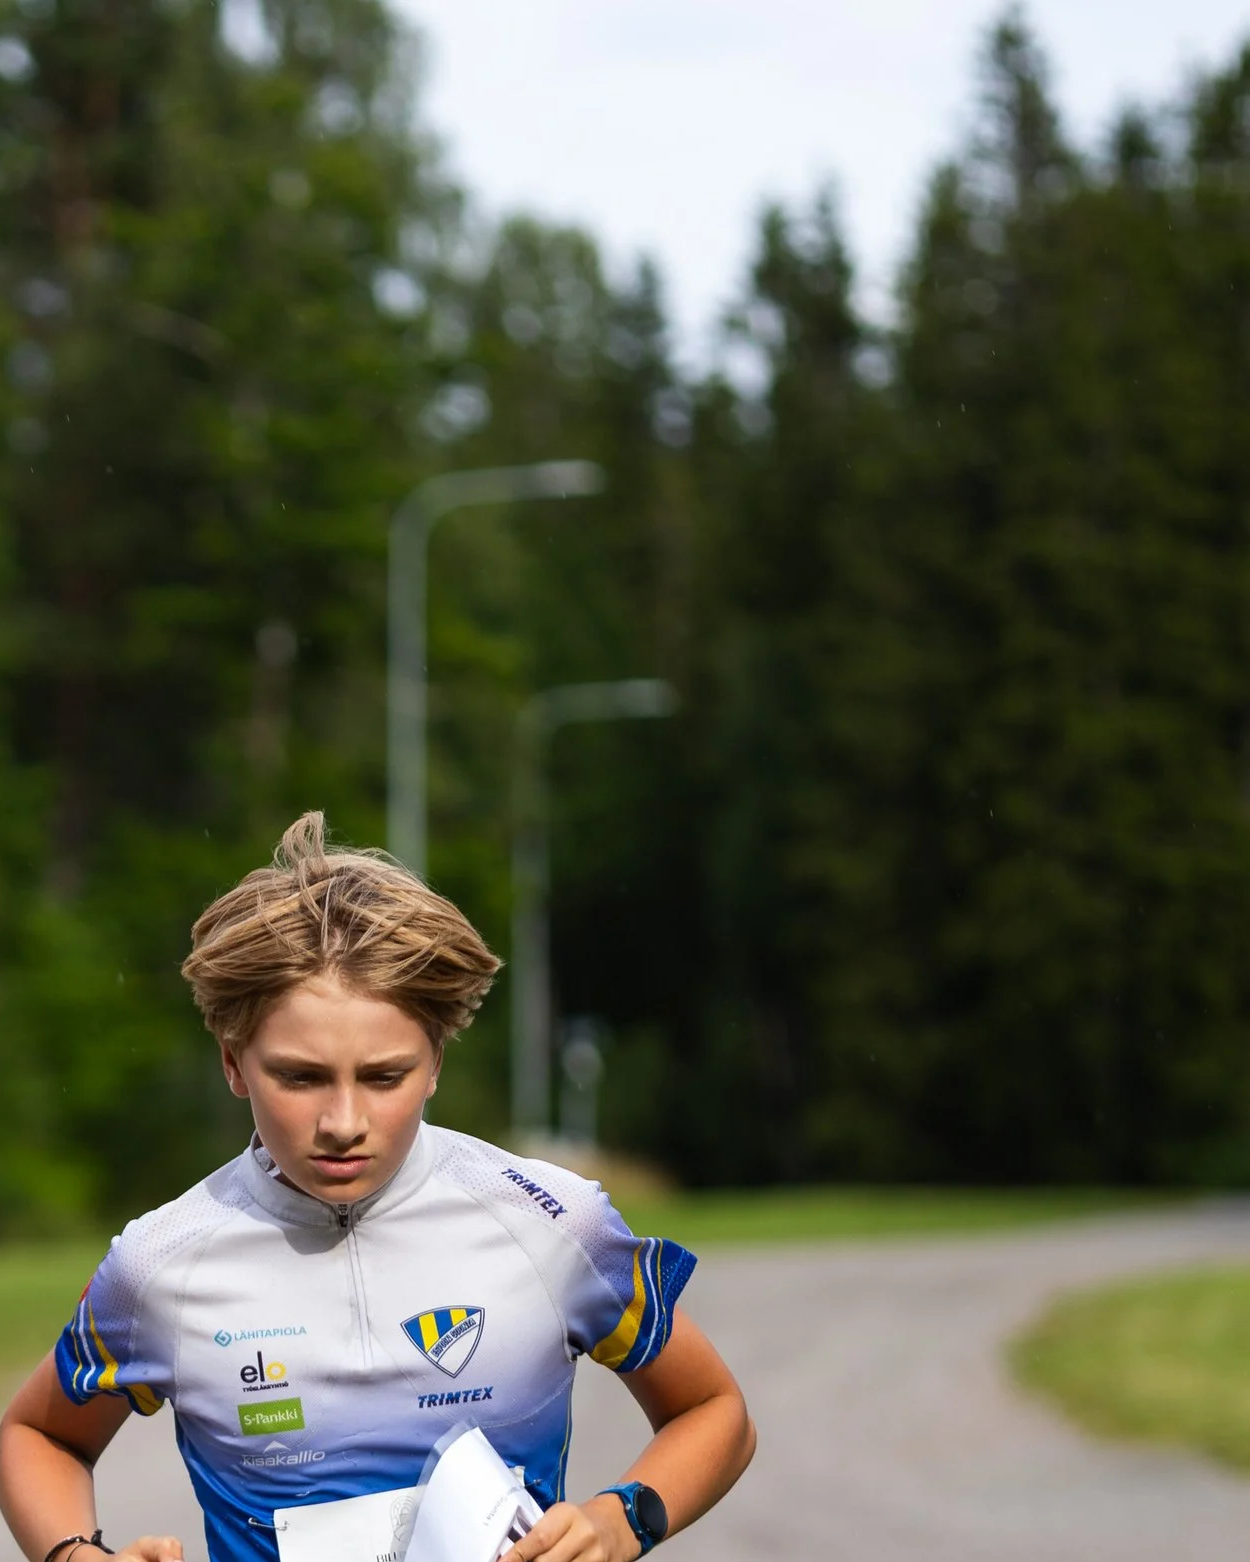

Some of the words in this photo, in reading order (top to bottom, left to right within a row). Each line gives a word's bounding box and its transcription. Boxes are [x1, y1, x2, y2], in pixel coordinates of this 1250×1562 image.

[501, 1167, 568, 1220] TRIMTEX
[233, 1325, 308, 1342] LÄHITAPIOLA
[240, 1350, 287, 1384] elo
[417, 1386, 494, 1409] TRIMTEX
[243, 1408, 299, 1426] S-Pankki
